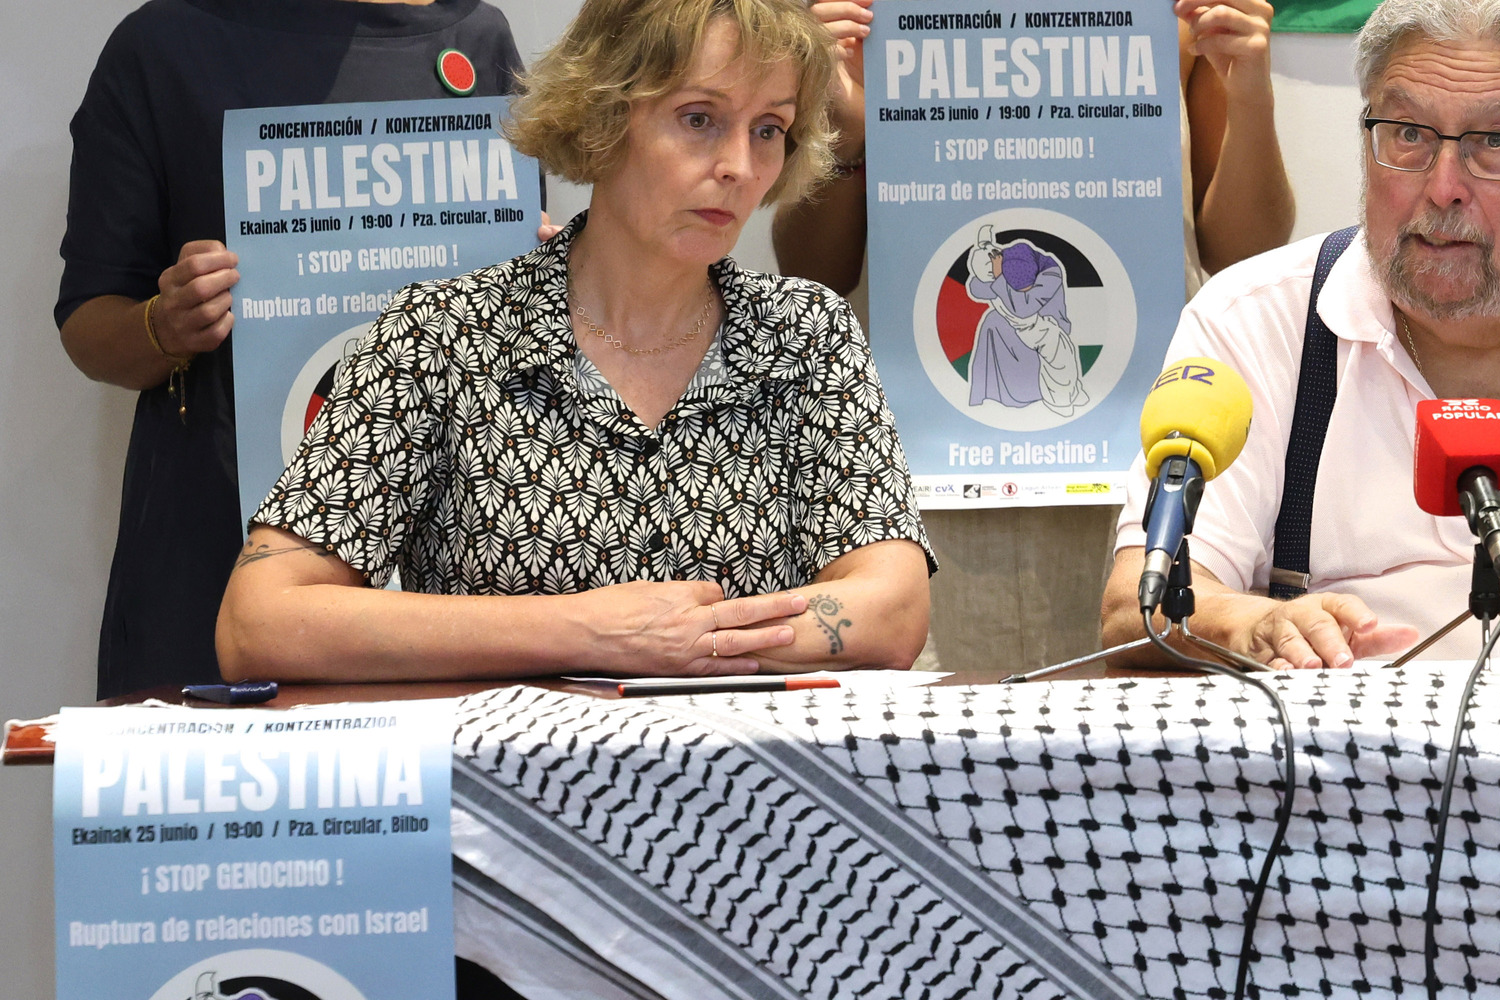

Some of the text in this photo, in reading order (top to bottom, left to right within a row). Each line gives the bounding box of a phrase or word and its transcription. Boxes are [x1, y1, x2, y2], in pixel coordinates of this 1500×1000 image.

[899, 10, 1132, 30] CONCENTRACIÓN / KONTZENTRAZIOA
[886, 35, 1157, 99] PALESTINA
[879, 104, 1162, 121] Ekainak 25 junio / 19:00 / Pza. Circular, Bilbo
[259, 114, 491, 140] CONCENTRACIÓN / KONTZENTRAZIOA
[935, 137, 1094, 162] ¡ STOP GENOCIDIO !
[246, 137, 518, 212] PALESTINA
[878, 177, 1162, 204] Ruptura de relaciones con Israel
[240, 209, 523, 235] Ekainak 25 junio / 19:00 / Pza. Circular, Bilbo
[298, 245, 458, 275] ¡ STOP GENOCIDIO !
[242, 296, 309, 321] Ruptura
[316, 293, 337, 314] de
[1150, 365, 1215, 394] ER
[949, 440, 1108, 466] Free Palestine !
[245, 723, 254, 734] /
[264, 716, 397, 732] KONTZENTRAZIOA
[81, 745, 423, 818] PALESTINA
[72, 816, 428, 845] Ekainak 25 junio / 19:00 / Pza. Circular, Bilbo
[142, 859, 343, 894] ¡ STOP GENOCIDIO !
[69, 908, 428, 949] Ruptura de relaciones con Israel
